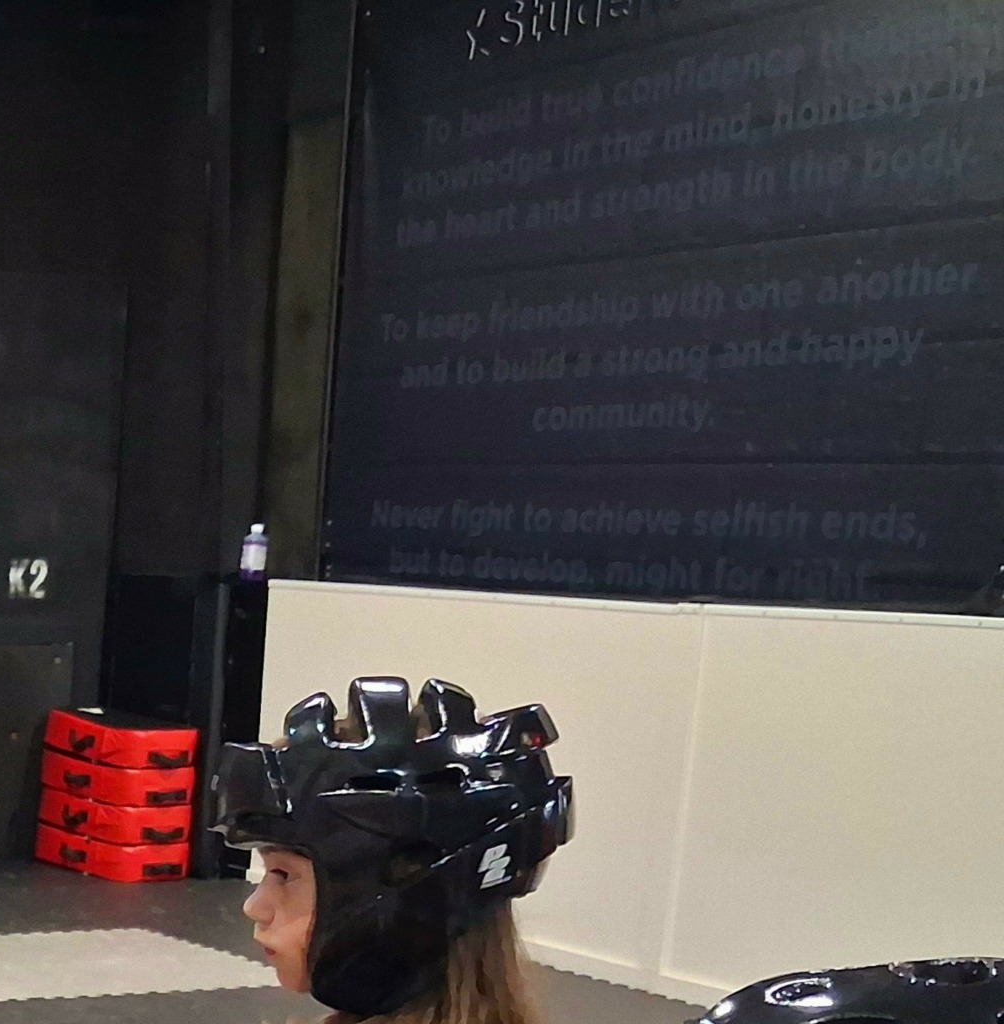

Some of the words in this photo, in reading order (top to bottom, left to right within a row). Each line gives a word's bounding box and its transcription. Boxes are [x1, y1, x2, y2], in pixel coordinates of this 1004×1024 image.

[402, 148, 553, 200] knowledge
[562, 136, 592, 171] in
[601, 129, 656, 164] the
[772, 79, 936, 135] honesty
[948, 64, 987, 102] in
[422, 114, 452, 146] To
[460, 92, 532, 138] build
[612, 44, 805, 108] confidence
[396, 216, 437, 248] the
[443, 201, 517, 241] heart
[525, 187, 583, 230] and
[590, 168, 732, 219] strength
[743, 158, 776, 199] in
[789, 150, 851, 193] the
[380, 312, 409, 342] To
[416, 309, 478, 342] keep
[488, 289, 638, 335] friendship
[651, 279, 725, 319] with
[736, 279, 804, 311] one
[816, 256, 980, 305] another
[400, 356, 450, 389] and
[456, 355, 484, 385] to
[492, 346, 566, 384] build
[573, 354, 594, 378] a
[599, 344, 709, 382] strong
[717, 330, 790, 368] and
[799, 326, 925, 369] happy
[371, 499, 446, 530] Never
[451, 498, 514, 537] fight
[523, 502, 552, 533] to
[560, 500, 682, 536] achieve
[693, 498, 810, 538] selfish
[821, 501, 927, 549] ends,
[8, 558, 48, 599] K2
[389, 546, 431, 575] but
[438, 548, 465, 577] to
[605, 555, 701, 595] might
[716, 556, 766, 592] for
